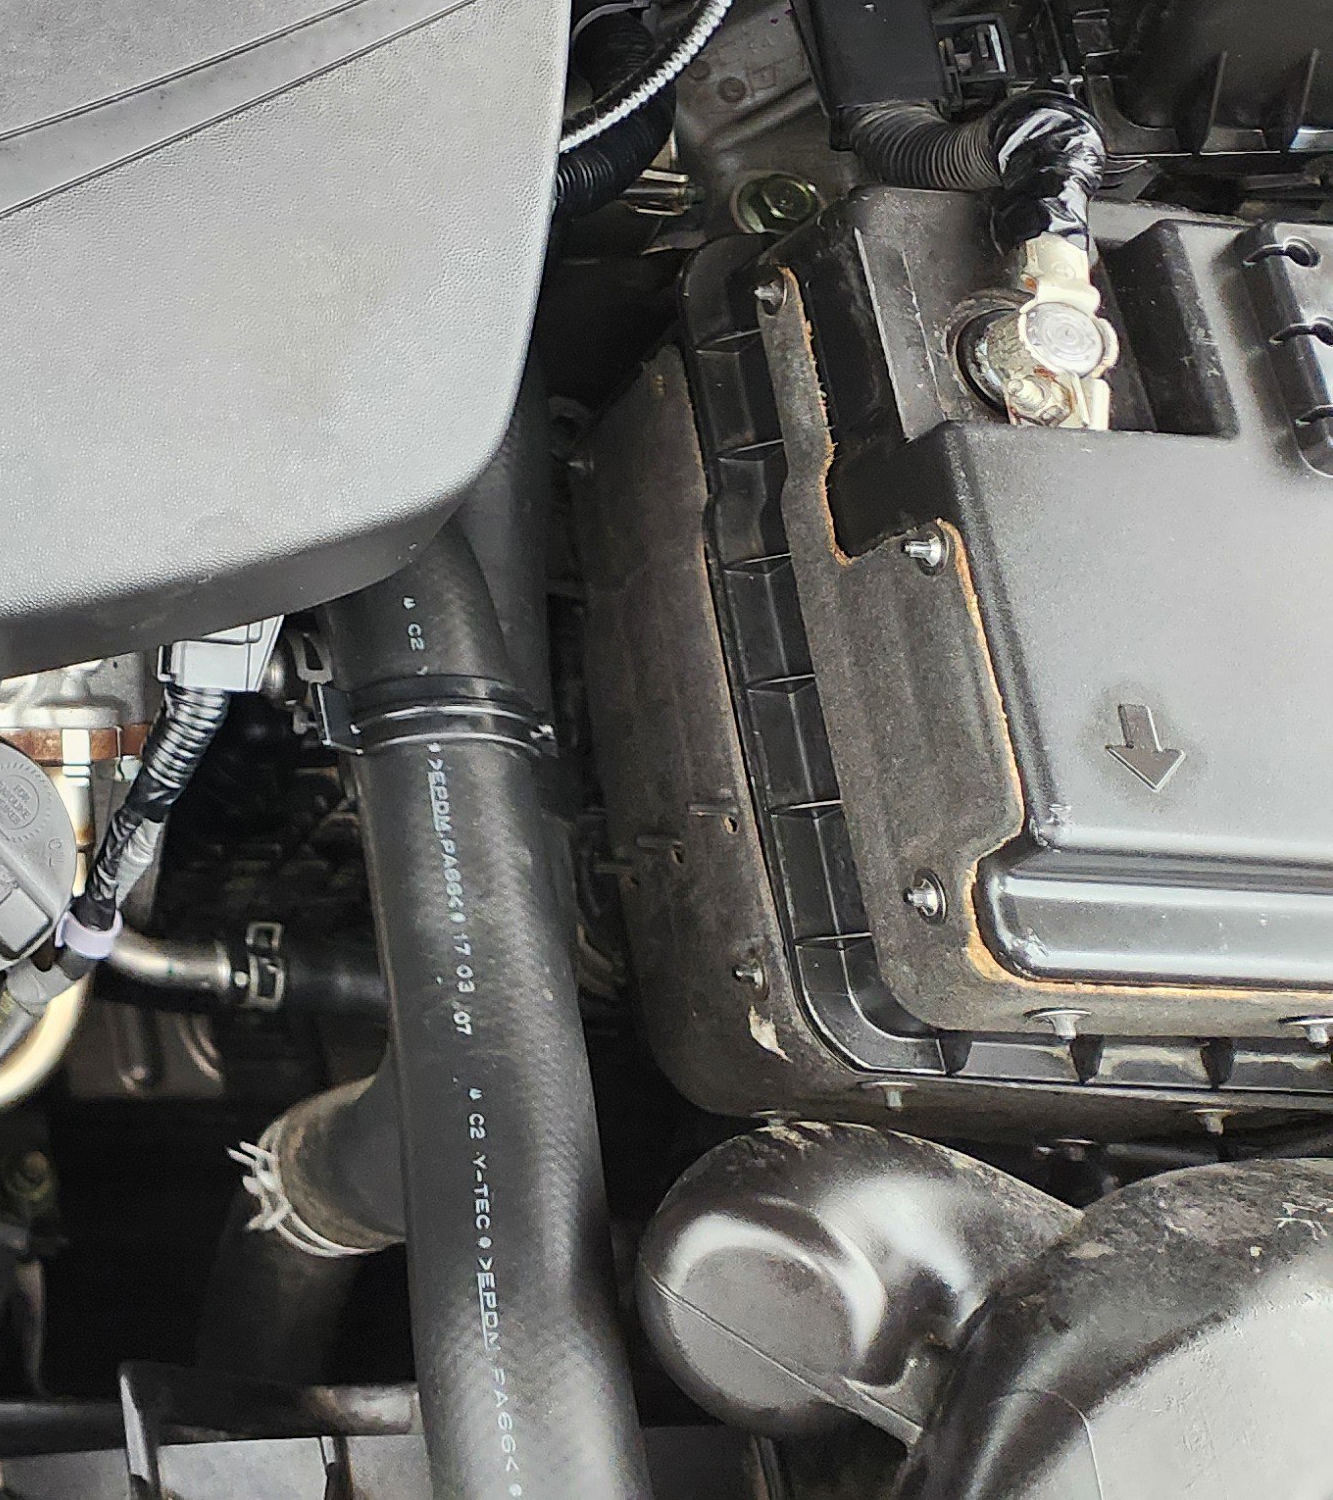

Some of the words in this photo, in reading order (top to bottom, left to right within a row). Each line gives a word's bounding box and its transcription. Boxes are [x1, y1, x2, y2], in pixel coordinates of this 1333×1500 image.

[451, 931, 470, 956] 17
[455, 963, 475, 992] 03
[452, 1009, 472, 1037] 07
[466, 1112, 486, 1141] C2
[466, 1154, 494, 1230] Y-TEC
